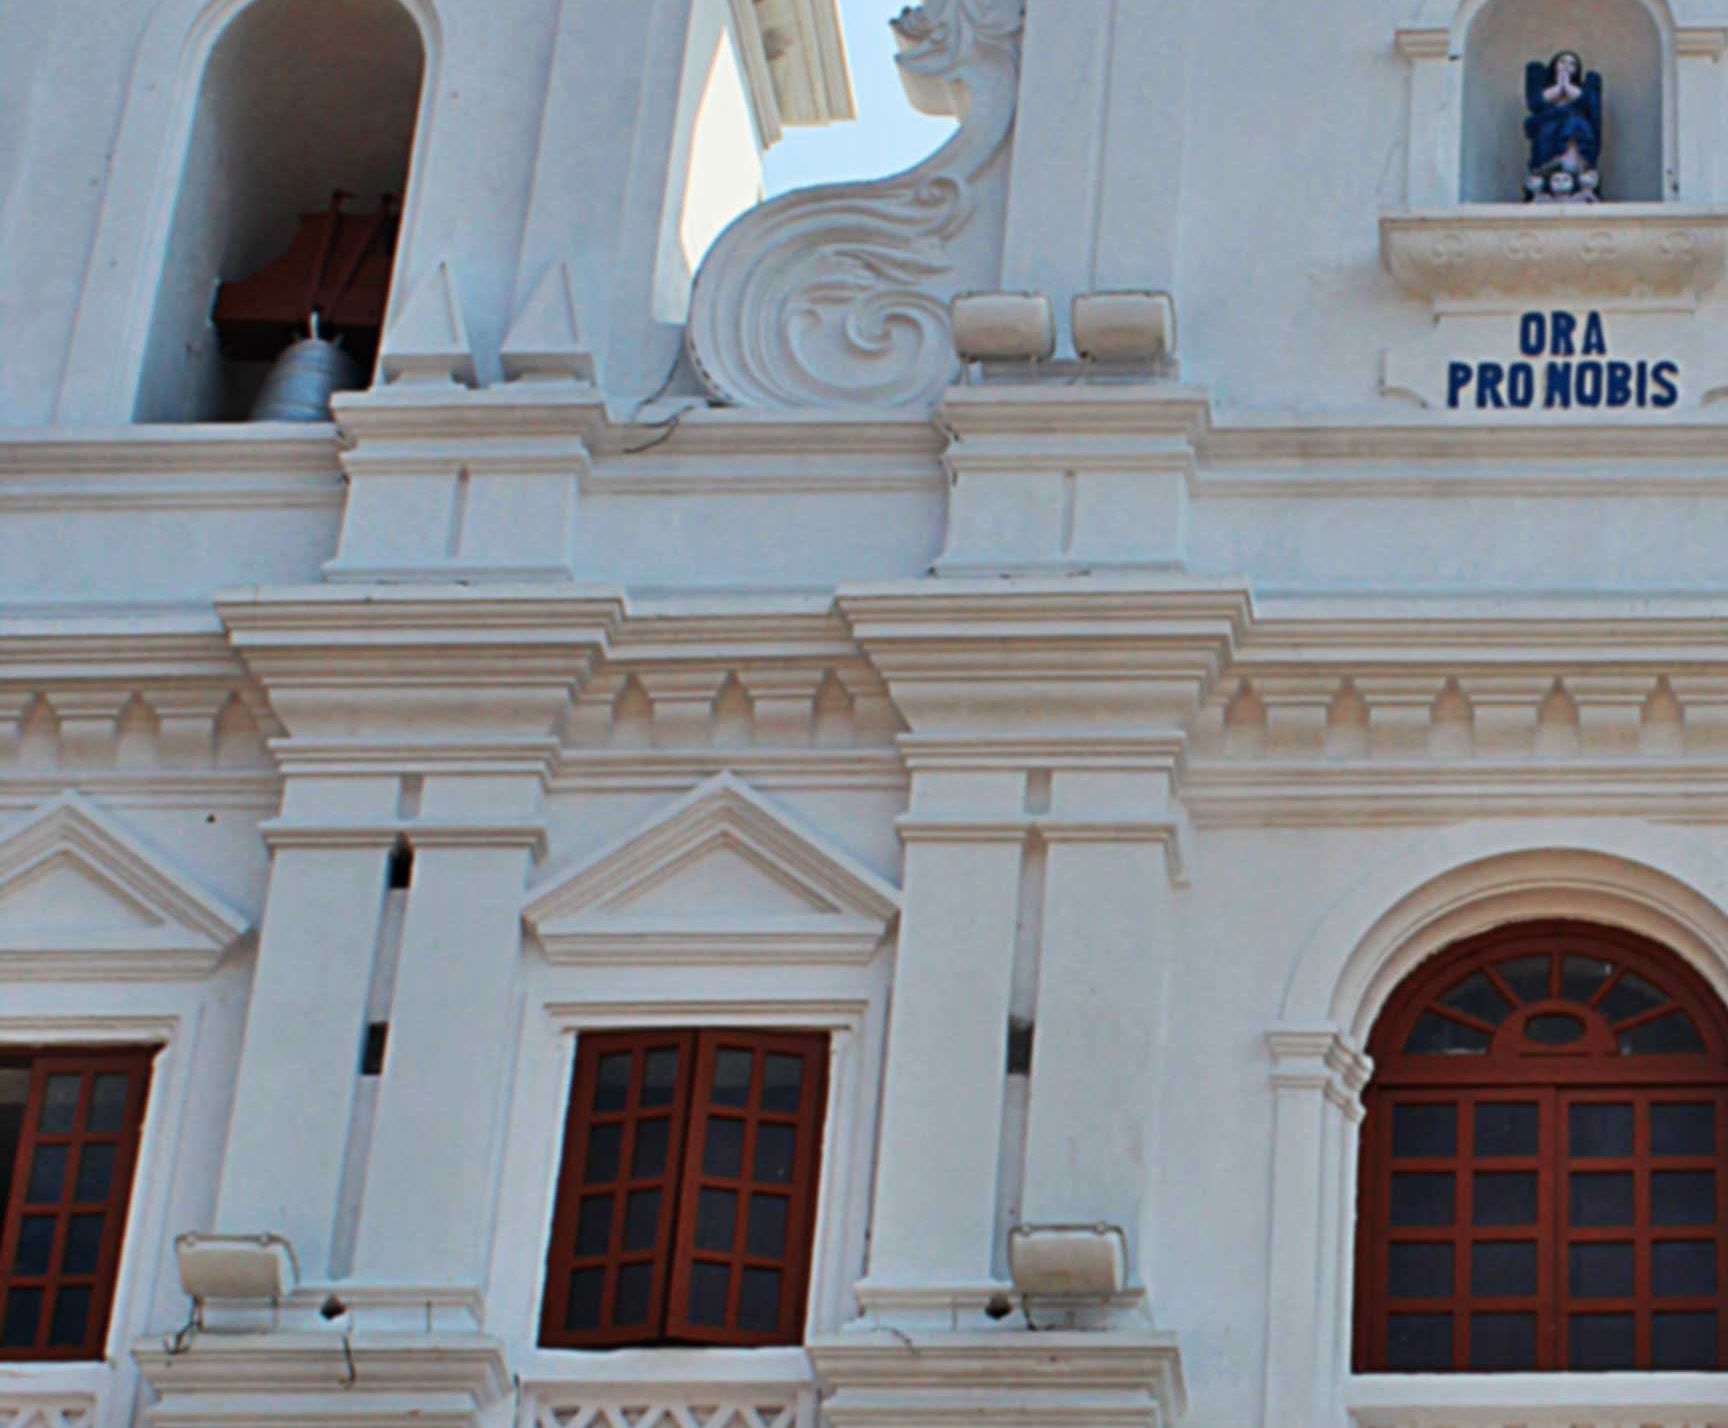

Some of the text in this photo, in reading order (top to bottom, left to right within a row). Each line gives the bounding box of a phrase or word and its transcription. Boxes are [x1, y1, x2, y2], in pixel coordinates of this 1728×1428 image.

[1519, 310, 1607, 357] ORA
[1446, 360, 1680, 409] PRO NOBIS
